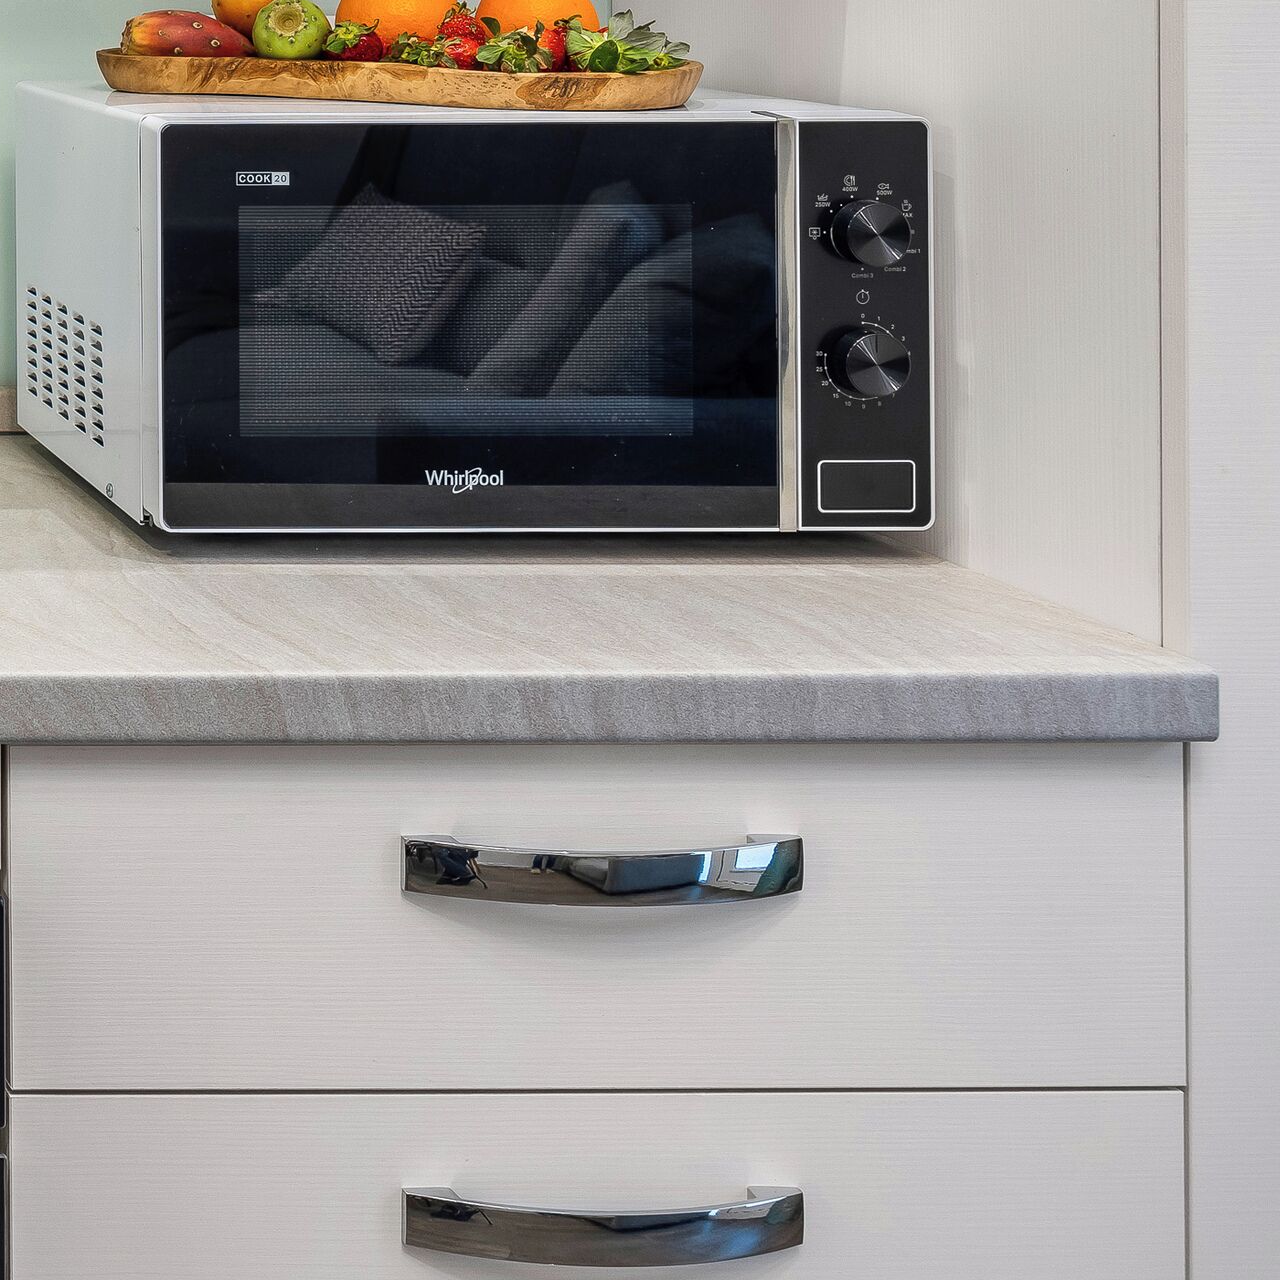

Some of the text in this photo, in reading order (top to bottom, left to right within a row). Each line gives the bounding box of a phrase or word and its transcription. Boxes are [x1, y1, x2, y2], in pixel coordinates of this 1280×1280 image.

[239, 174, 287, 183] COOK 20
[424, 468, 504, 493] Whirlpool
